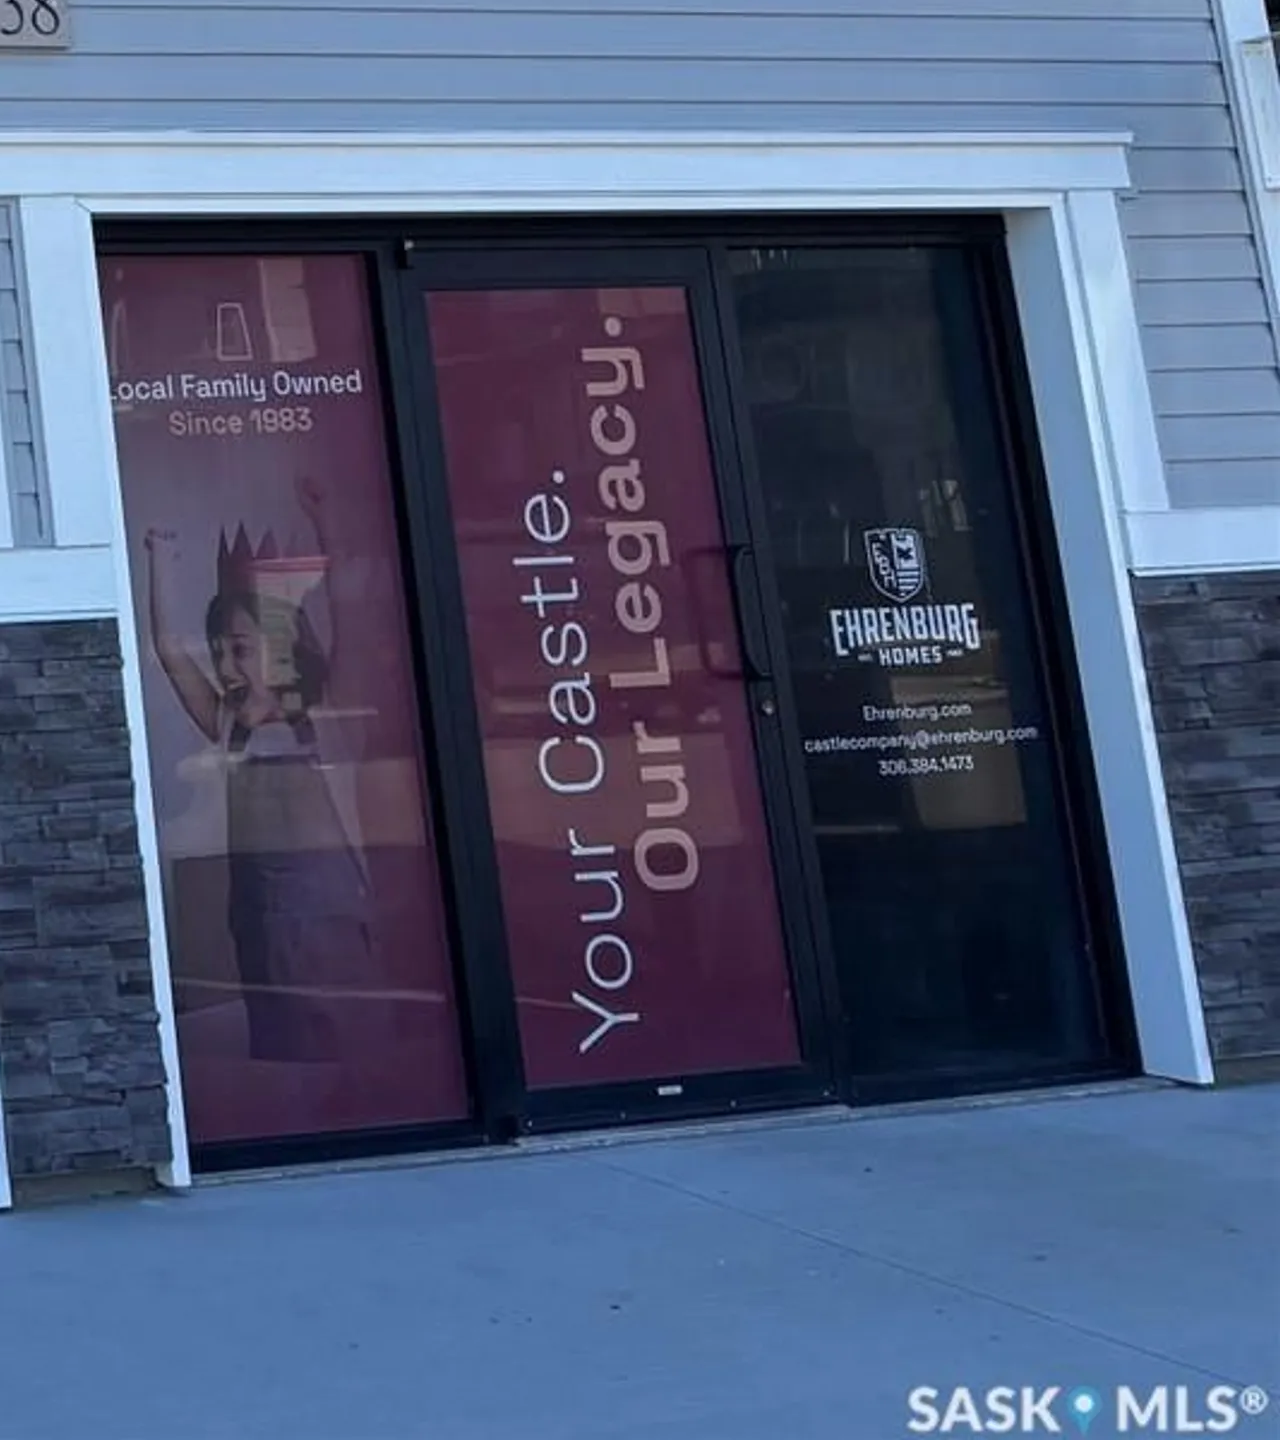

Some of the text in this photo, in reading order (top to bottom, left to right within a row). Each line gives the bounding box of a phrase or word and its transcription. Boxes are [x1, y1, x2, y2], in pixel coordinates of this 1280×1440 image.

[180, 374, 266, 401] Family
[274, 369, 362, 396] Owned
[169, 407, 313, 436] Since 1983
[581, 317, 699, 892] Our Legacy.
[830, 603, 981, 656] EHRENBURG
[879, 645, 943, 667] HOMES
[862, 702, 973, 722] Ehrenburg.com
[804, 726, 1039, 753] castlecompany@ehrenburg.com
[513, 470, 640, 1053] Your Castle.
[878, 754, 975, 776] 306.384.1473
